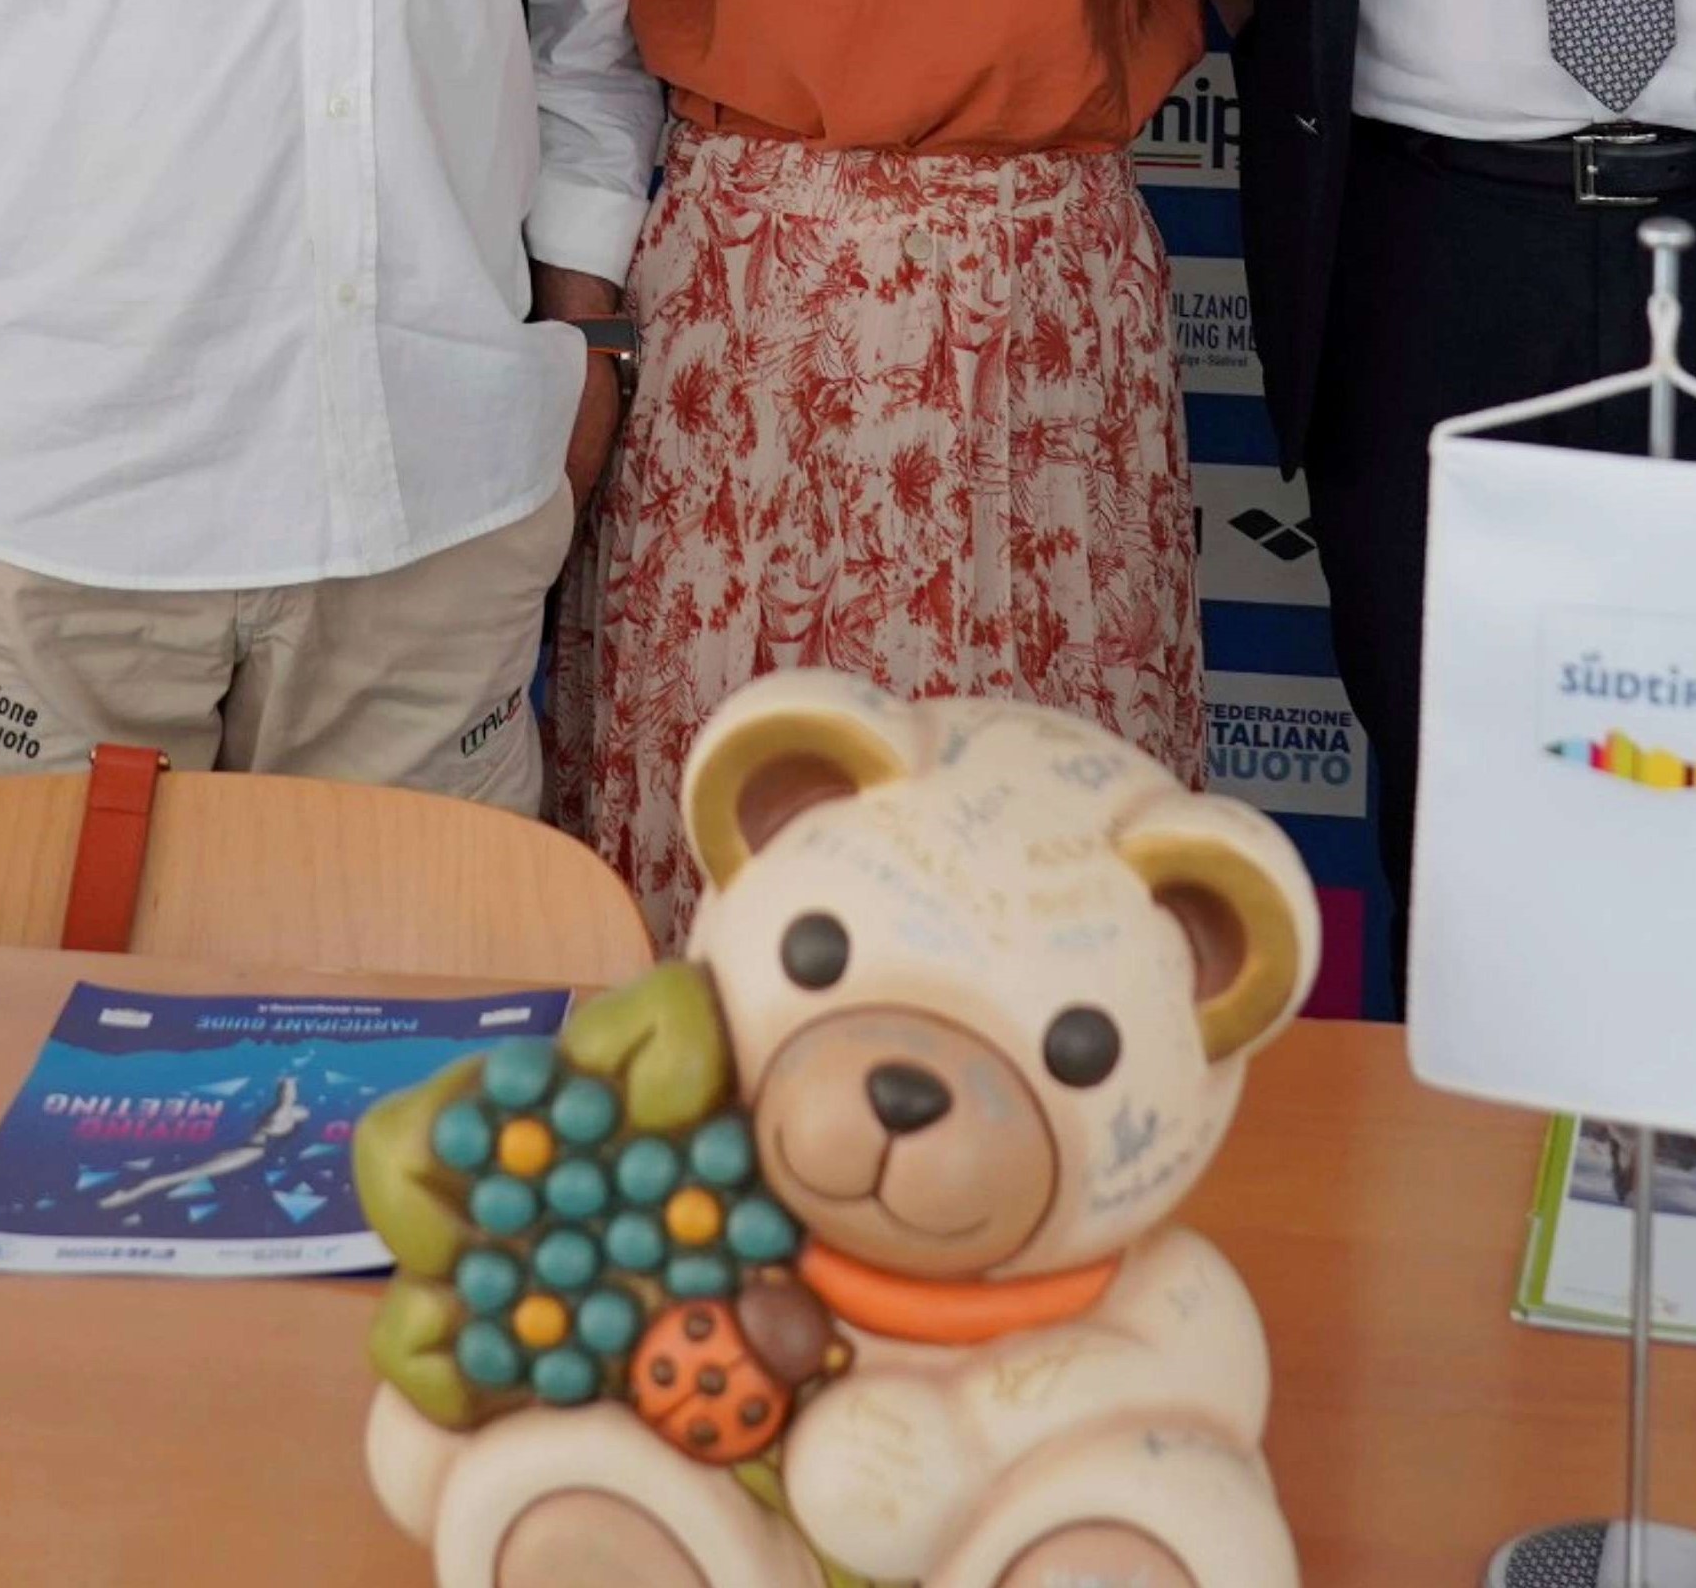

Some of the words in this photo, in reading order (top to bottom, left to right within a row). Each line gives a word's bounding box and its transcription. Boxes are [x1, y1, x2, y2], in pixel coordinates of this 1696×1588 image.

[1207, 746, 1352, 786] NUOTO
[195, 1016, 265, 1033] GUIDE
[272, 1015, 419, 1034] PARTICIPANT
[44, 1092, 225, 1118] MEETING
